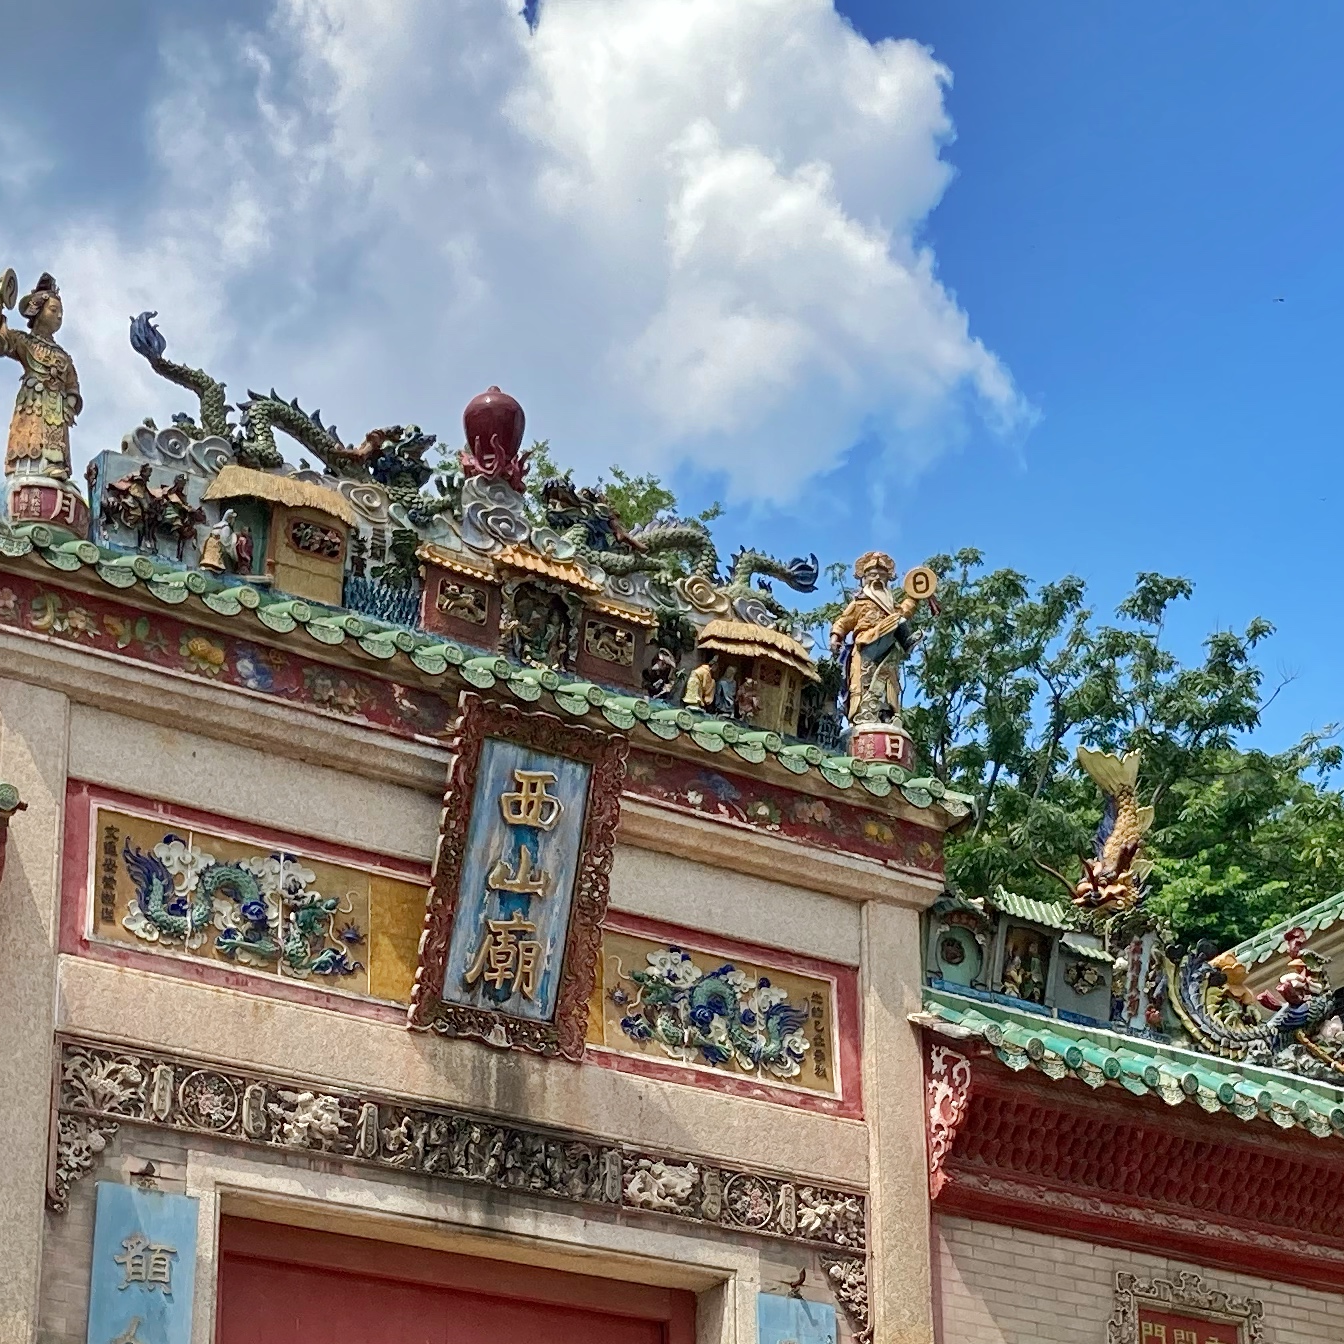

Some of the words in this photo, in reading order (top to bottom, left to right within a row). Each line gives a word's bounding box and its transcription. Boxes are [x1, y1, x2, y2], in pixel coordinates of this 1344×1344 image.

[50, 489, 76, 524] 月
[885, 735, 904, 759] 日
[464, 768, 564, 1003] 西山廟
